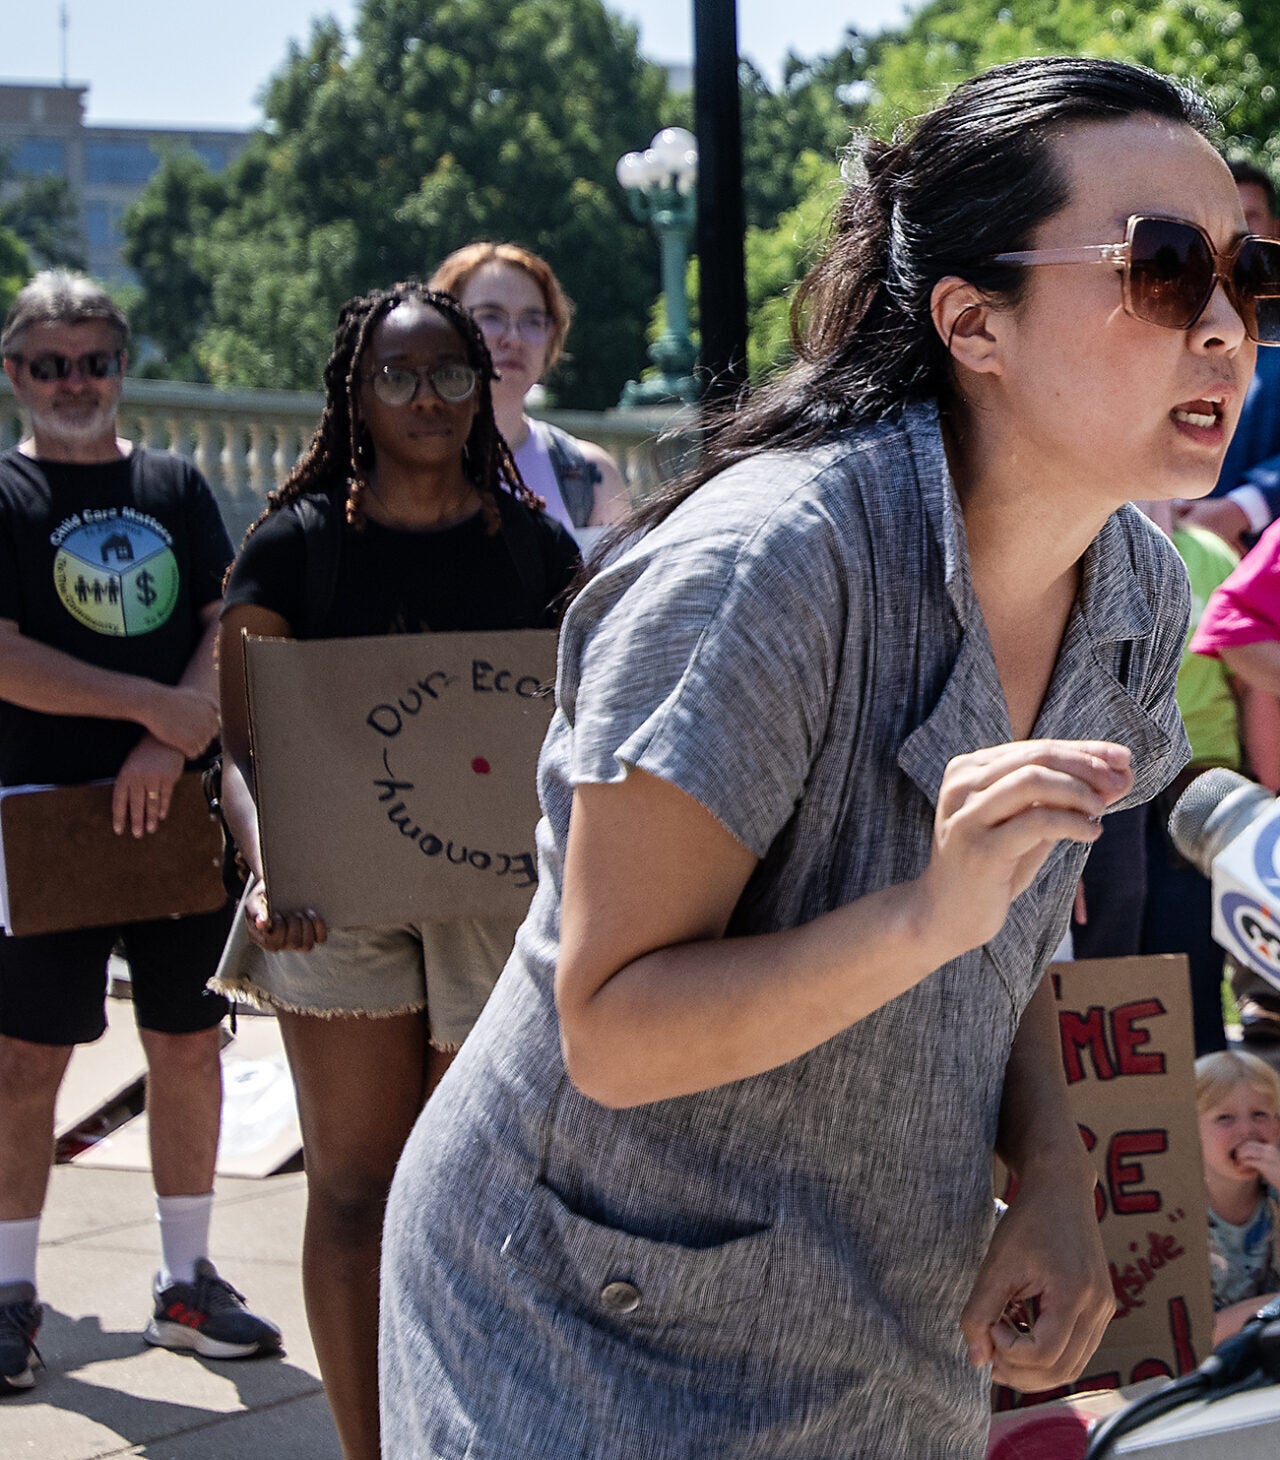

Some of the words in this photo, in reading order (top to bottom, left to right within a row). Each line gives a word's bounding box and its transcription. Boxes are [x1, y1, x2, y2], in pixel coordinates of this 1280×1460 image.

[50, 513, 82, 546] Child
[83, 507, 117, 523] Care
[122, 506, 173, 545] Matters
[366, 670, 452, 738] Our
[471, 659, 555, 701] Eco
